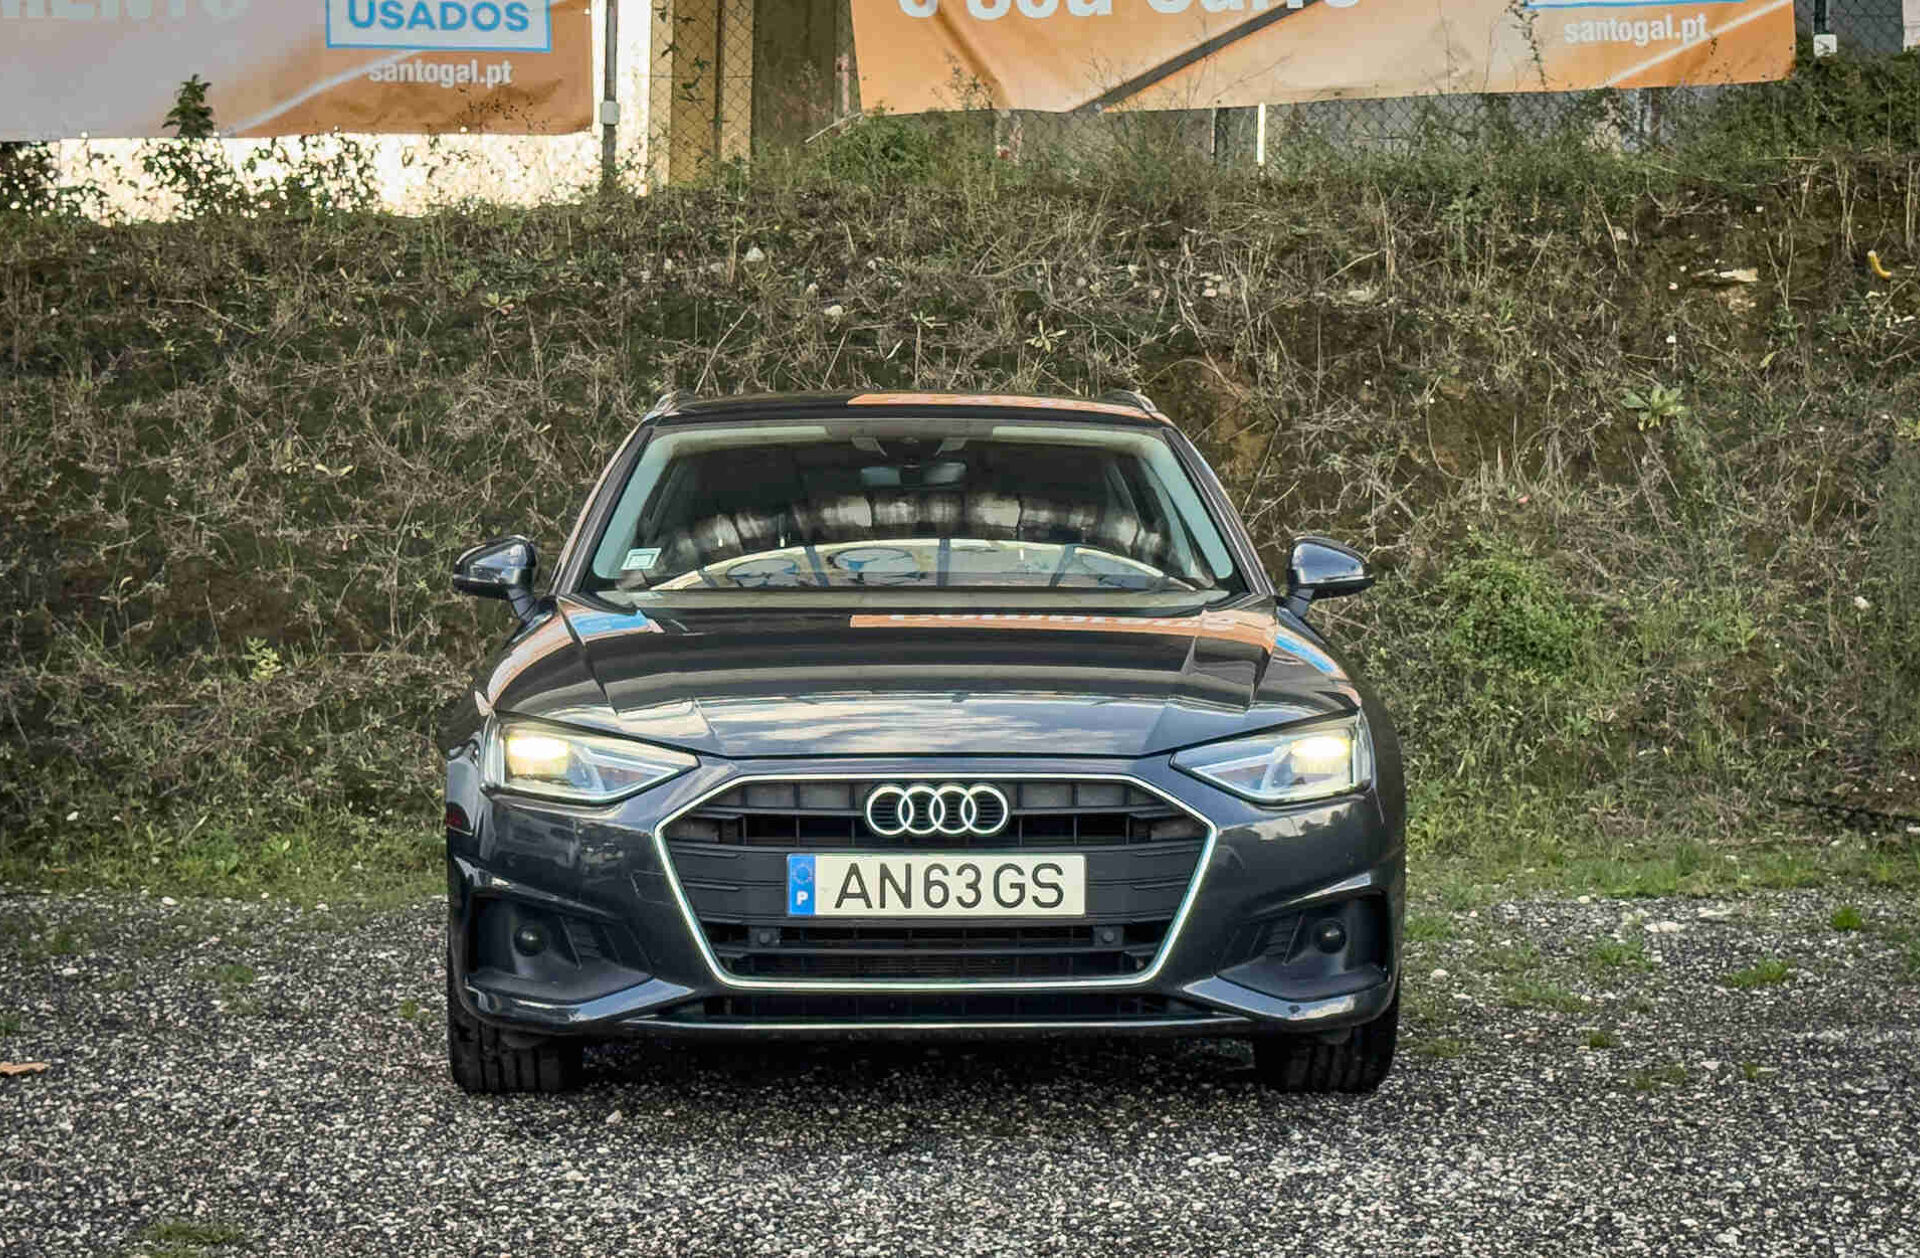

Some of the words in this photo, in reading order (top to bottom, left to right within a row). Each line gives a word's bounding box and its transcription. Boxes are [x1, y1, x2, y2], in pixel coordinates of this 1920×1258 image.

[349, 0, 529, 31] USADOS
[1563, 13, 1708, 47] santogal.pt
[368, 59, 513, 88] santogal.pt
[796, 890, 809, 906] P
